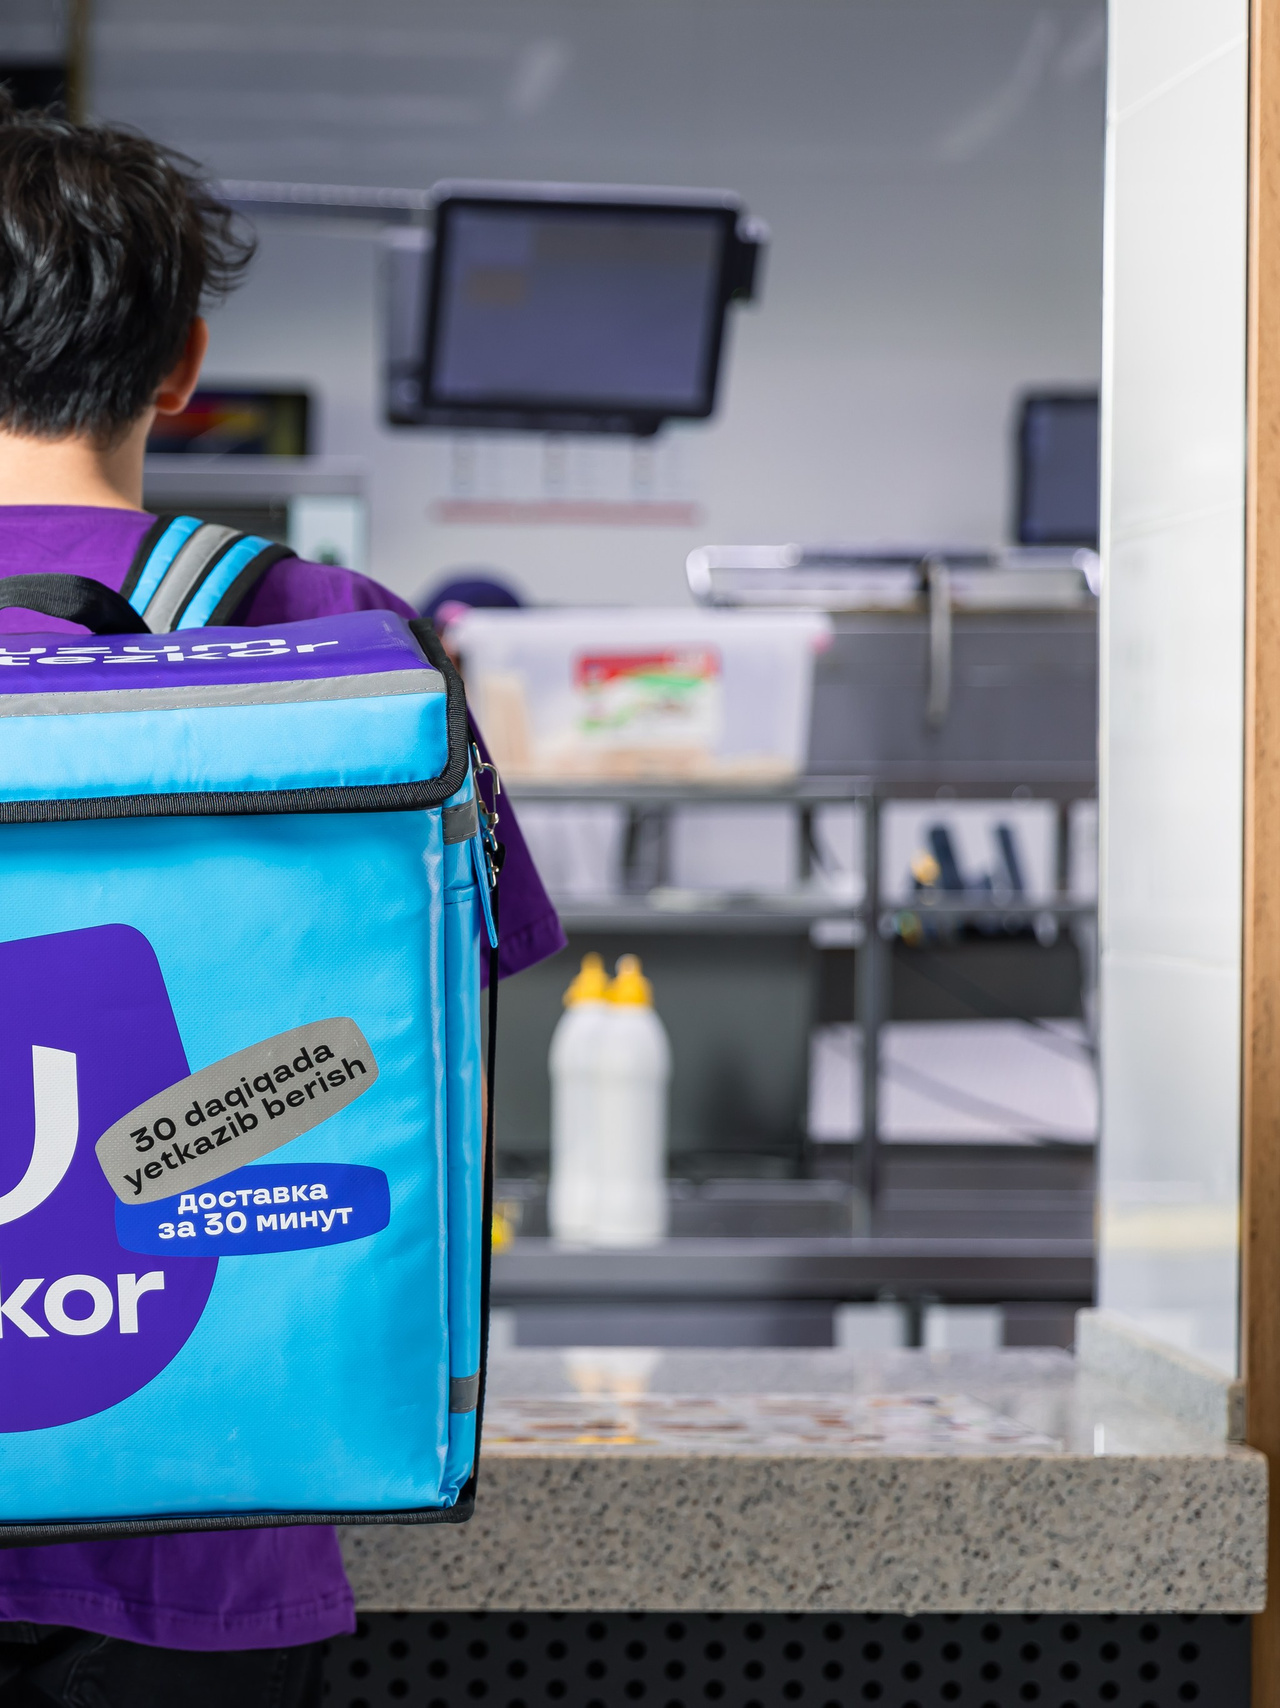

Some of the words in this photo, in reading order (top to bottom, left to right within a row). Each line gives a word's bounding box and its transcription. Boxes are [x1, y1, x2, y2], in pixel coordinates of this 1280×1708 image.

[123, 1112, 259, 1195] yetkazib
[261, 1057, 367, 1121] berish
[129, 1117, 176, 1153] 30
[184, 1044, 335, 1127] daqiqada
[158, 1221, 197, 1240] за
[204, 1212, 248, 1236] 30
[256, 1206, 354, 1233] минут
[177, 1183, 329, 1215] доставка
